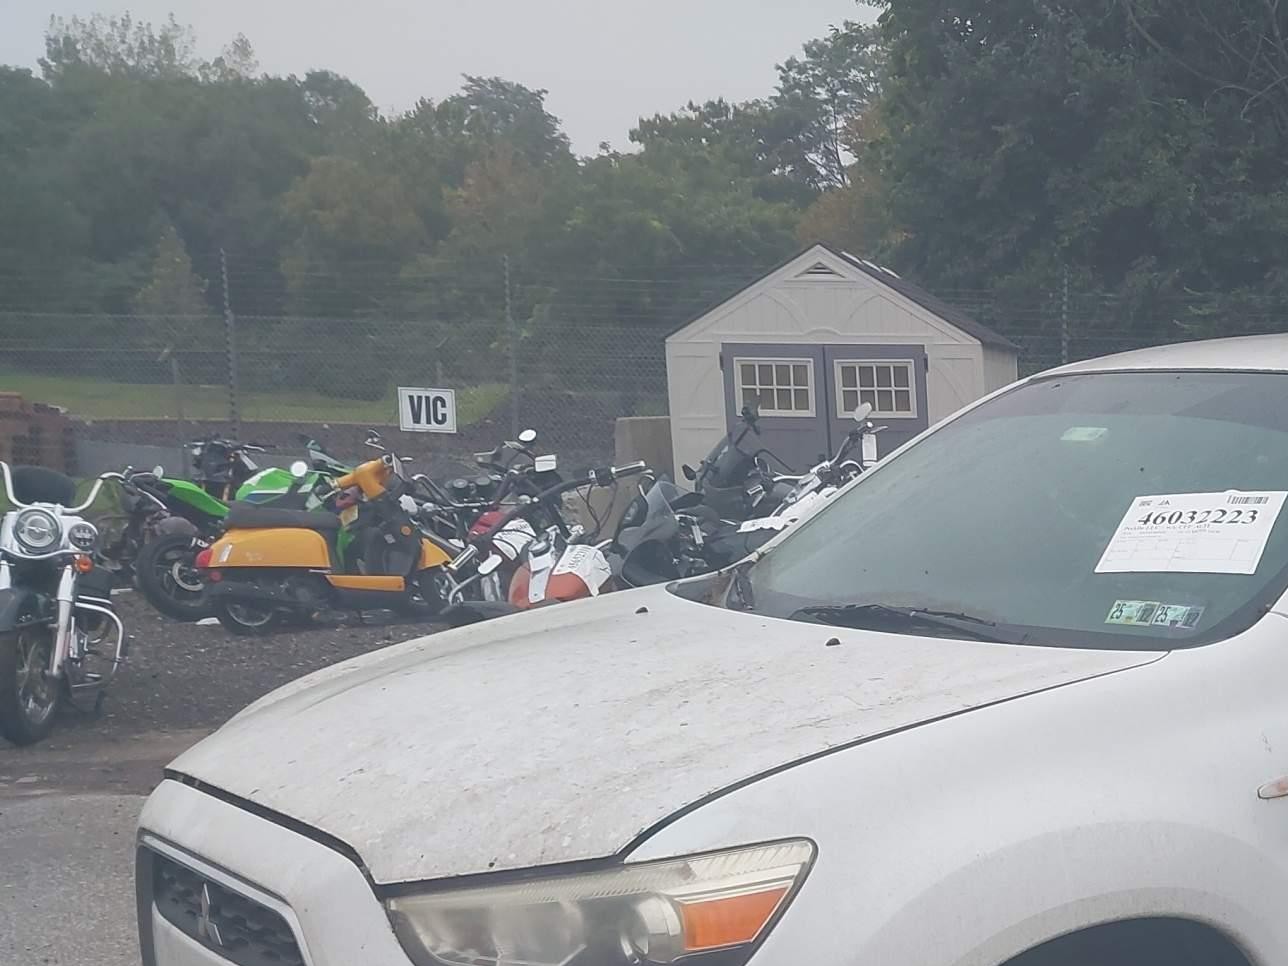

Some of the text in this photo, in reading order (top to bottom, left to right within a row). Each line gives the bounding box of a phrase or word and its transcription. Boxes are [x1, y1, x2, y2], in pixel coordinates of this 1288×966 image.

[408, 395, 447, 425] VIC
[1138, 509, 1258, 525] 46032223
[1110, 603, 1126, 619] 25
[1155, 606, 1171, 622] 25
